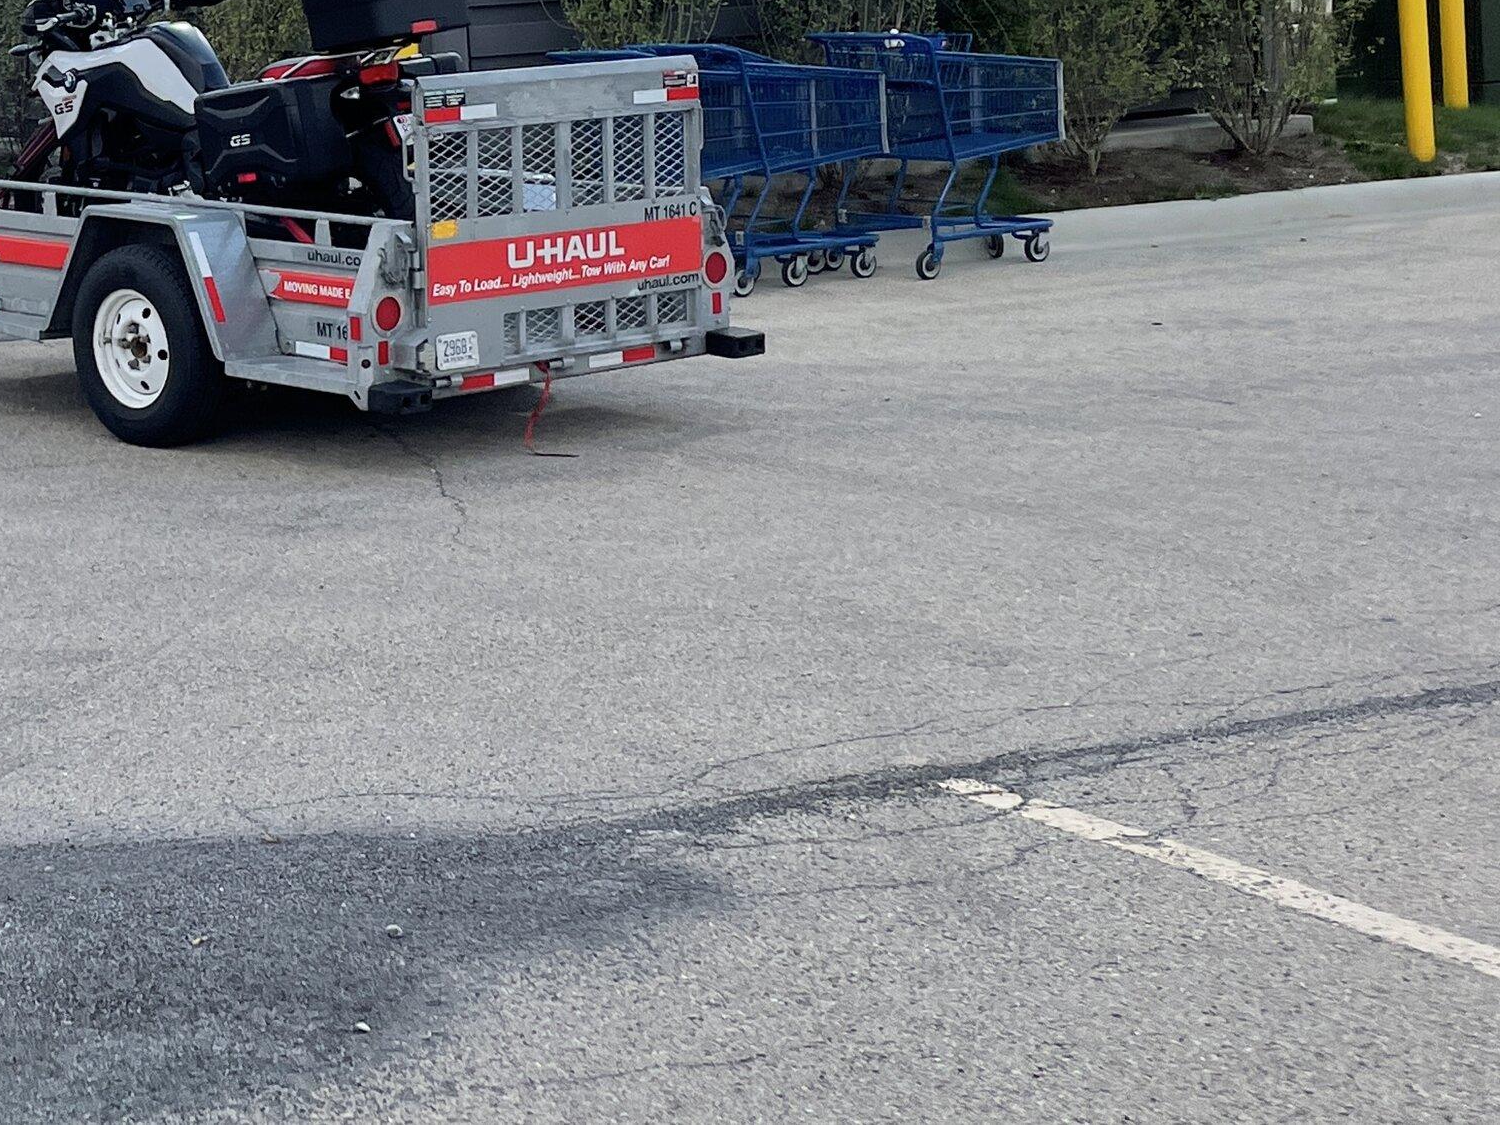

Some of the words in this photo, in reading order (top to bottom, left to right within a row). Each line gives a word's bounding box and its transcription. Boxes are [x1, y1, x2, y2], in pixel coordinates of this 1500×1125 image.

[55, 100, 73, 115] GS
[230, 134, 251, 147] GS
[644, 205, 660, 222] MT
[664, 203, 686, 219] 1641
[689, 201, 697, 216] C
[507, 230, 625, 269] U-HAUL
[432, 283, 457, 297] Easy
[459, 279, 472, 293] To
[581, 264, 602, 279] Tow
[604, 261, 626, 275] With
[628, 259, 648, 273] Any
[637, 273, 699, 291] uhaul.com
[283, 280, 318, 296] MOVING
[319, 285, 343, 299] MADE
[316, 321, 333, 338] MT
